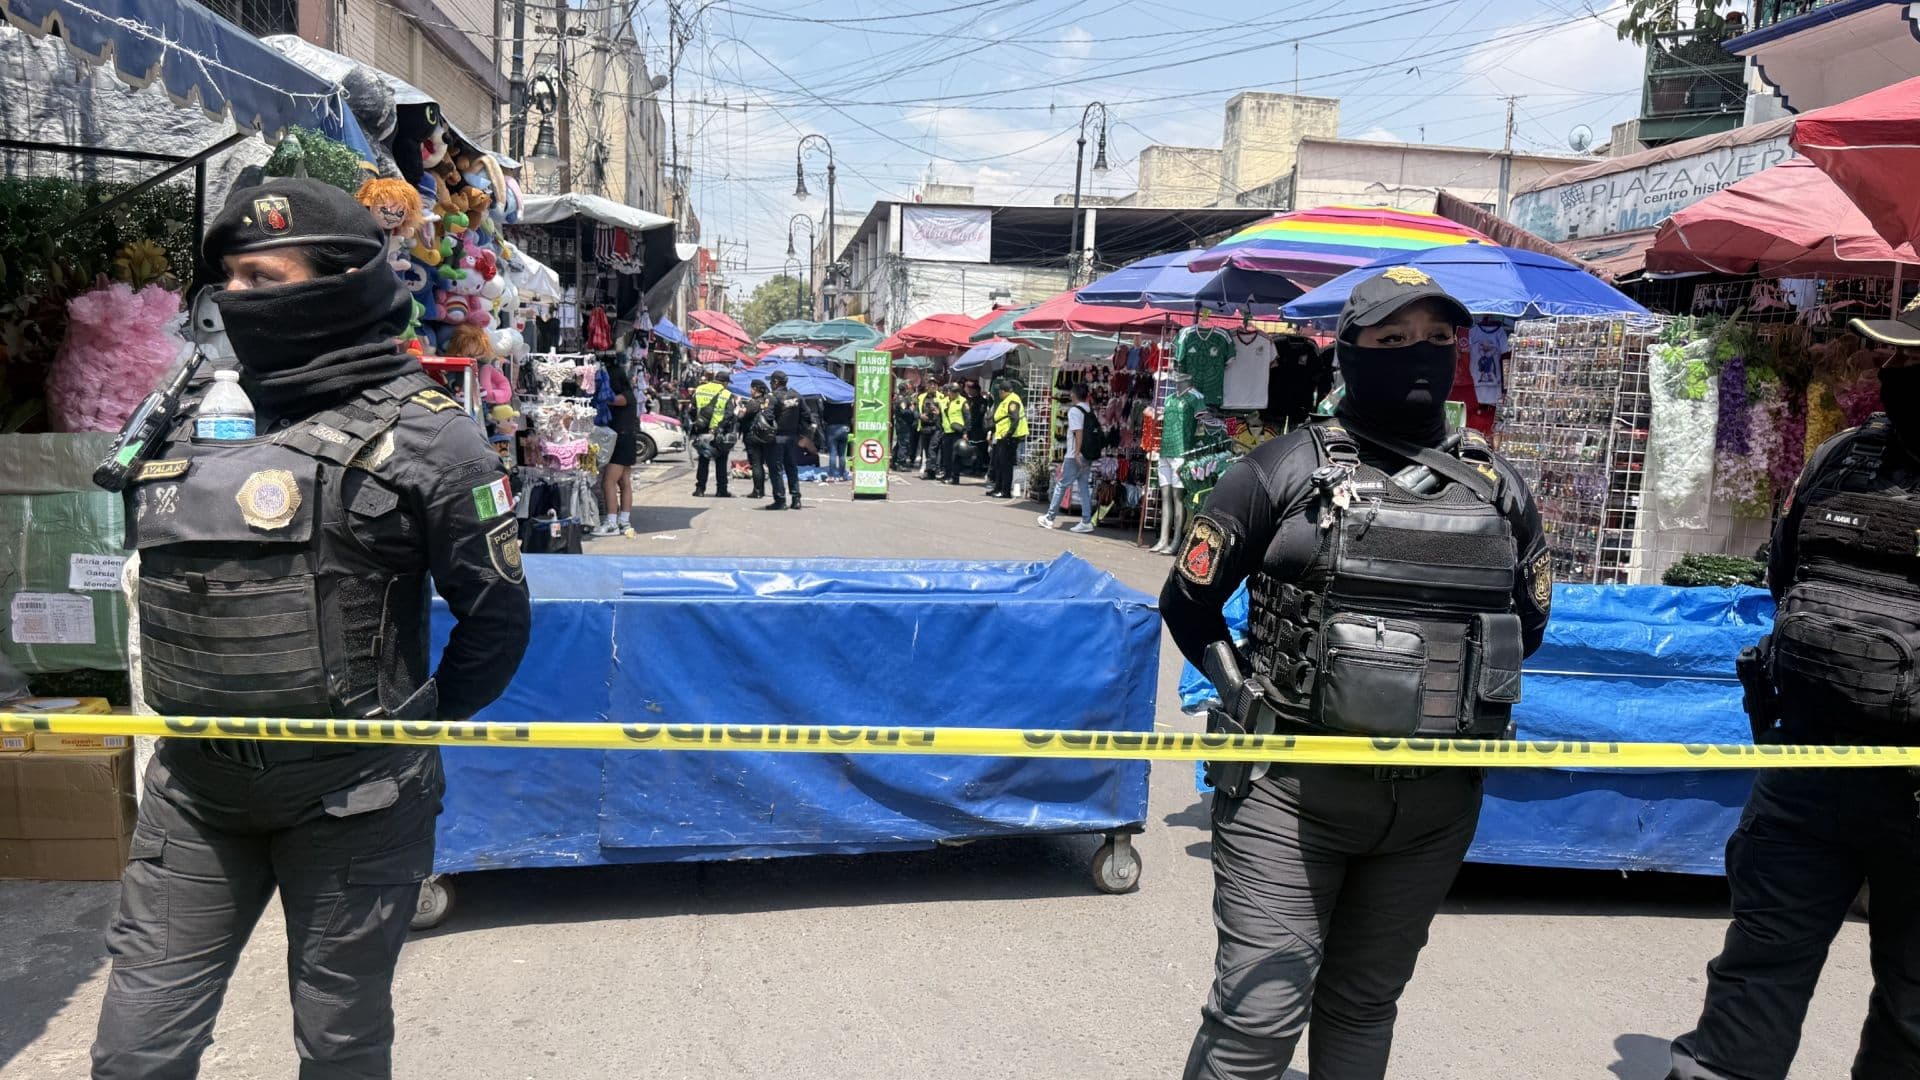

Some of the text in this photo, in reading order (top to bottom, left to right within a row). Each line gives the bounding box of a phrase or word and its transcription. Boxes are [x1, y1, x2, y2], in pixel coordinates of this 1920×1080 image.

[1590, 149, 1800, 203] PLAZA VER
[1643, 187, 1688, 205] centro
[858, 421, 888, 431] TIENDA
